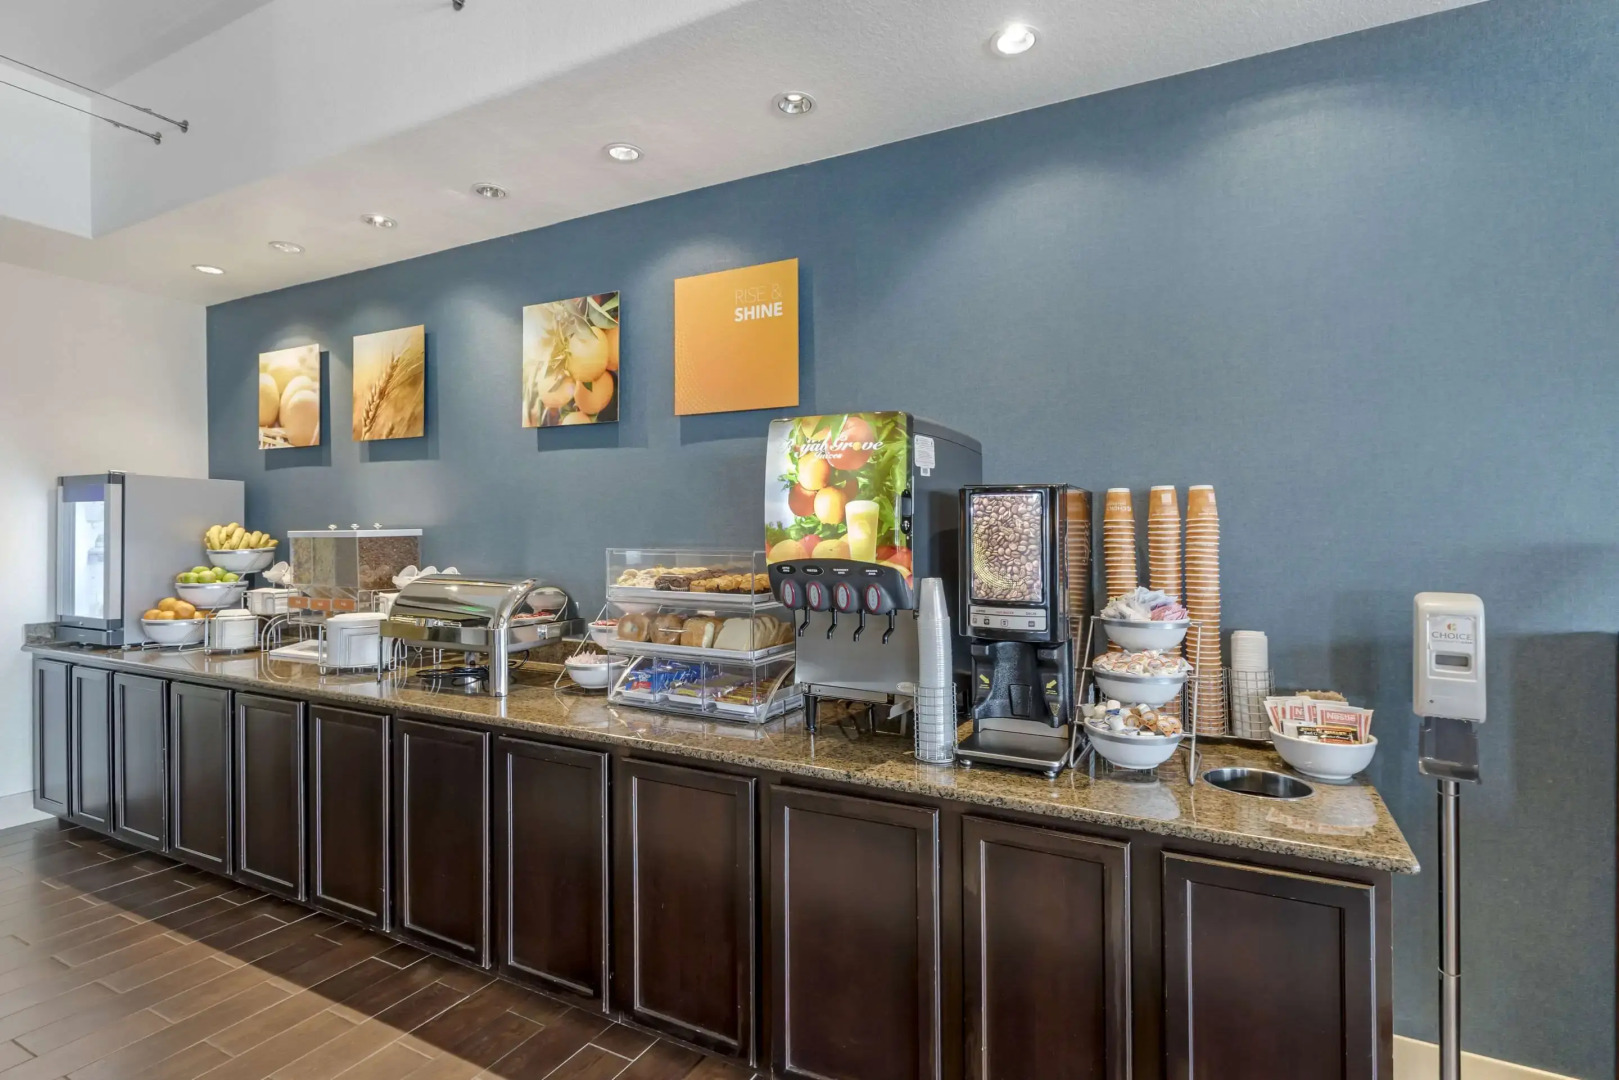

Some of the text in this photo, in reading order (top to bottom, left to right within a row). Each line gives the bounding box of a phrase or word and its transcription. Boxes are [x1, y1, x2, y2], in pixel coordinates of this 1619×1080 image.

[735, 283, 783, 304] RISE &
[734, 302, 783, 322] SHINE
[1431, 631, 1473, 641] CHOICE
